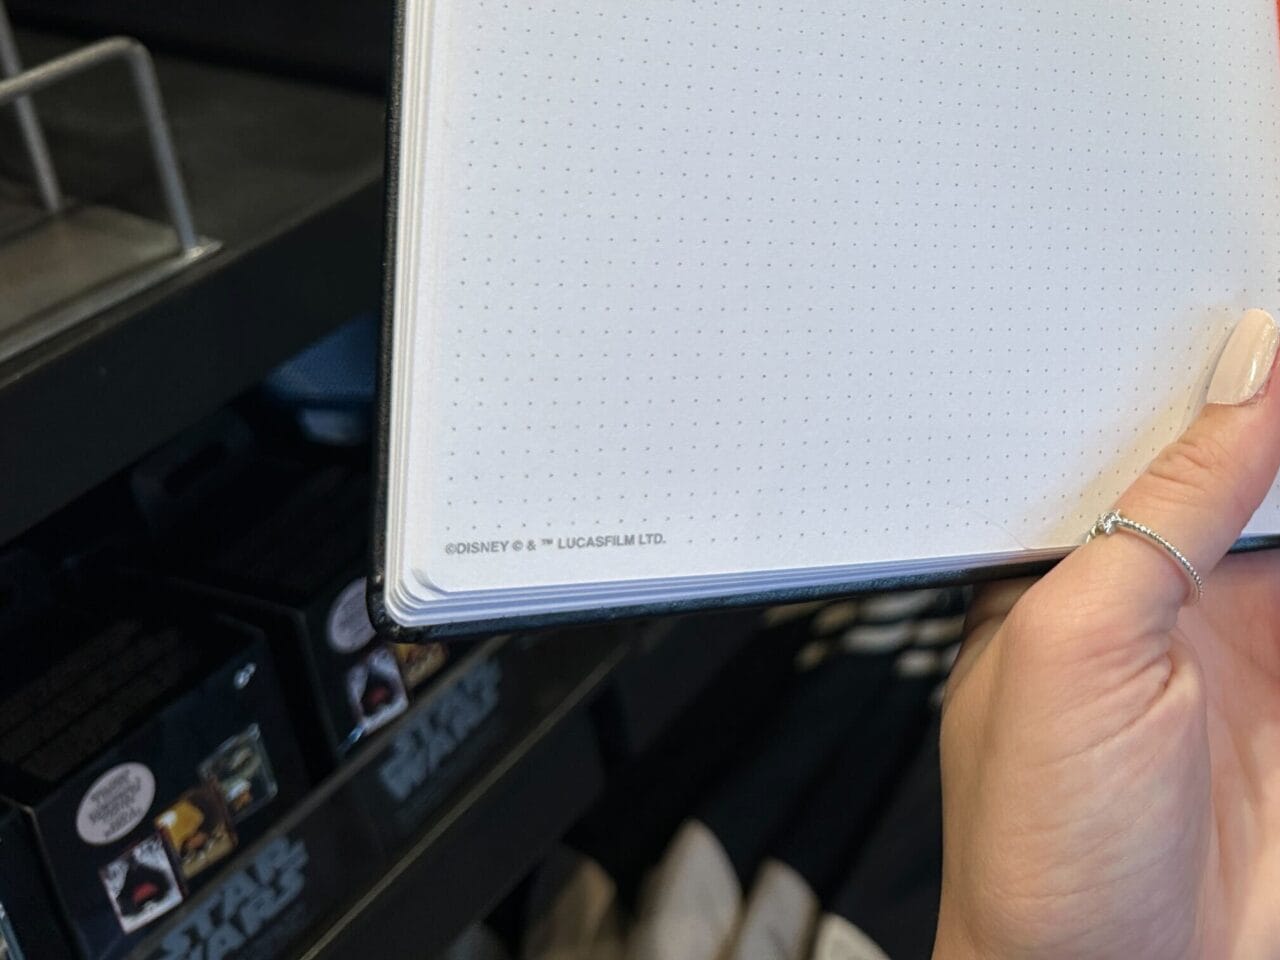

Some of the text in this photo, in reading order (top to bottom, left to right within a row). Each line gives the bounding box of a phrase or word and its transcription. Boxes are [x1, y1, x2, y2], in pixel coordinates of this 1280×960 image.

[526, 540, 537, 552] &
[557, 534, 635, 549] LUCASFILM
[638, 533, 667, 545] LTD.
[157, 838, 309, 960] STAR
[188, 869, 304, 960] ARS
